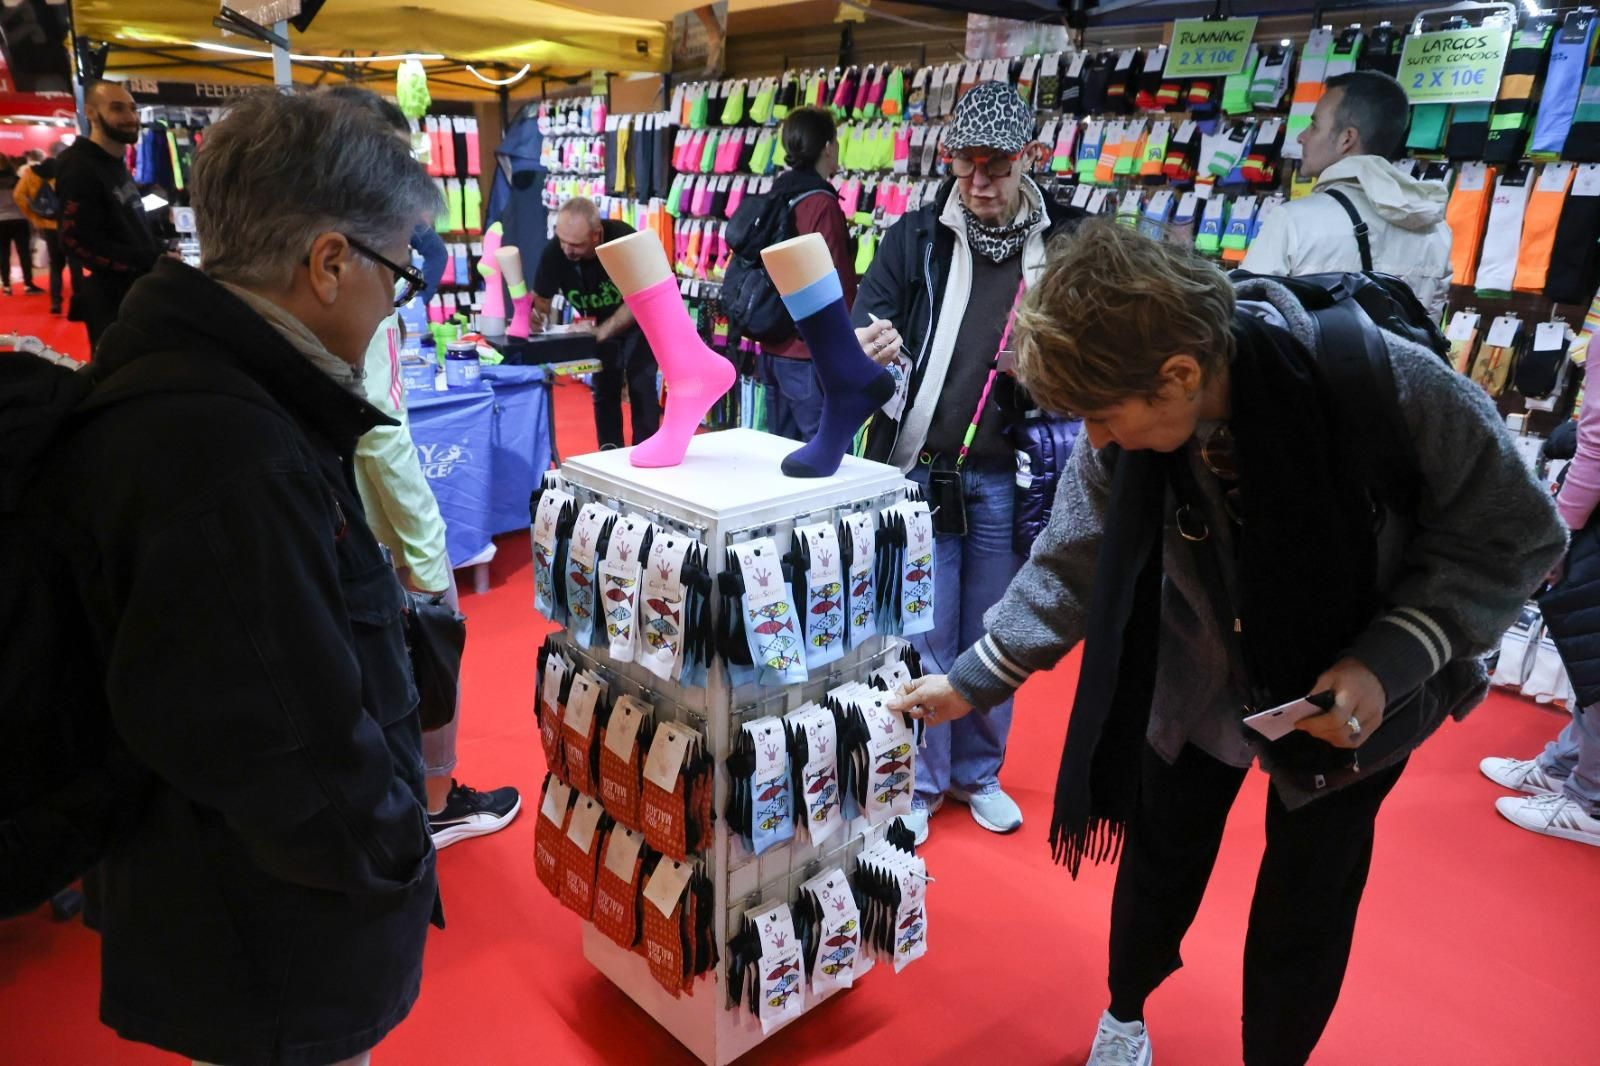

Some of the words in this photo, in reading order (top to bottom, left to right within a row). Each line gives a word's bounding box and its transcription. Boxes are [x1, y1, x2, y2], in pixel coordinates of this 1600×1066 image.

[1181, 30, 1246, 44] RUNNING
[1422, 35, 1488, 53] LARGOS
[1179, 51, 1190, 65] 2
[1193, 50, 1206, 64] X
[1210, 48, 1237, 63] 10€
[1407, 55, 1442, 66] SUPER
[1446, 50, 1500, 63] COMODOS
[1413, 72, 1425, 88] 2
[1428, 70, 1444, 88] X
[1451, 68, 1487, 86] 10€
